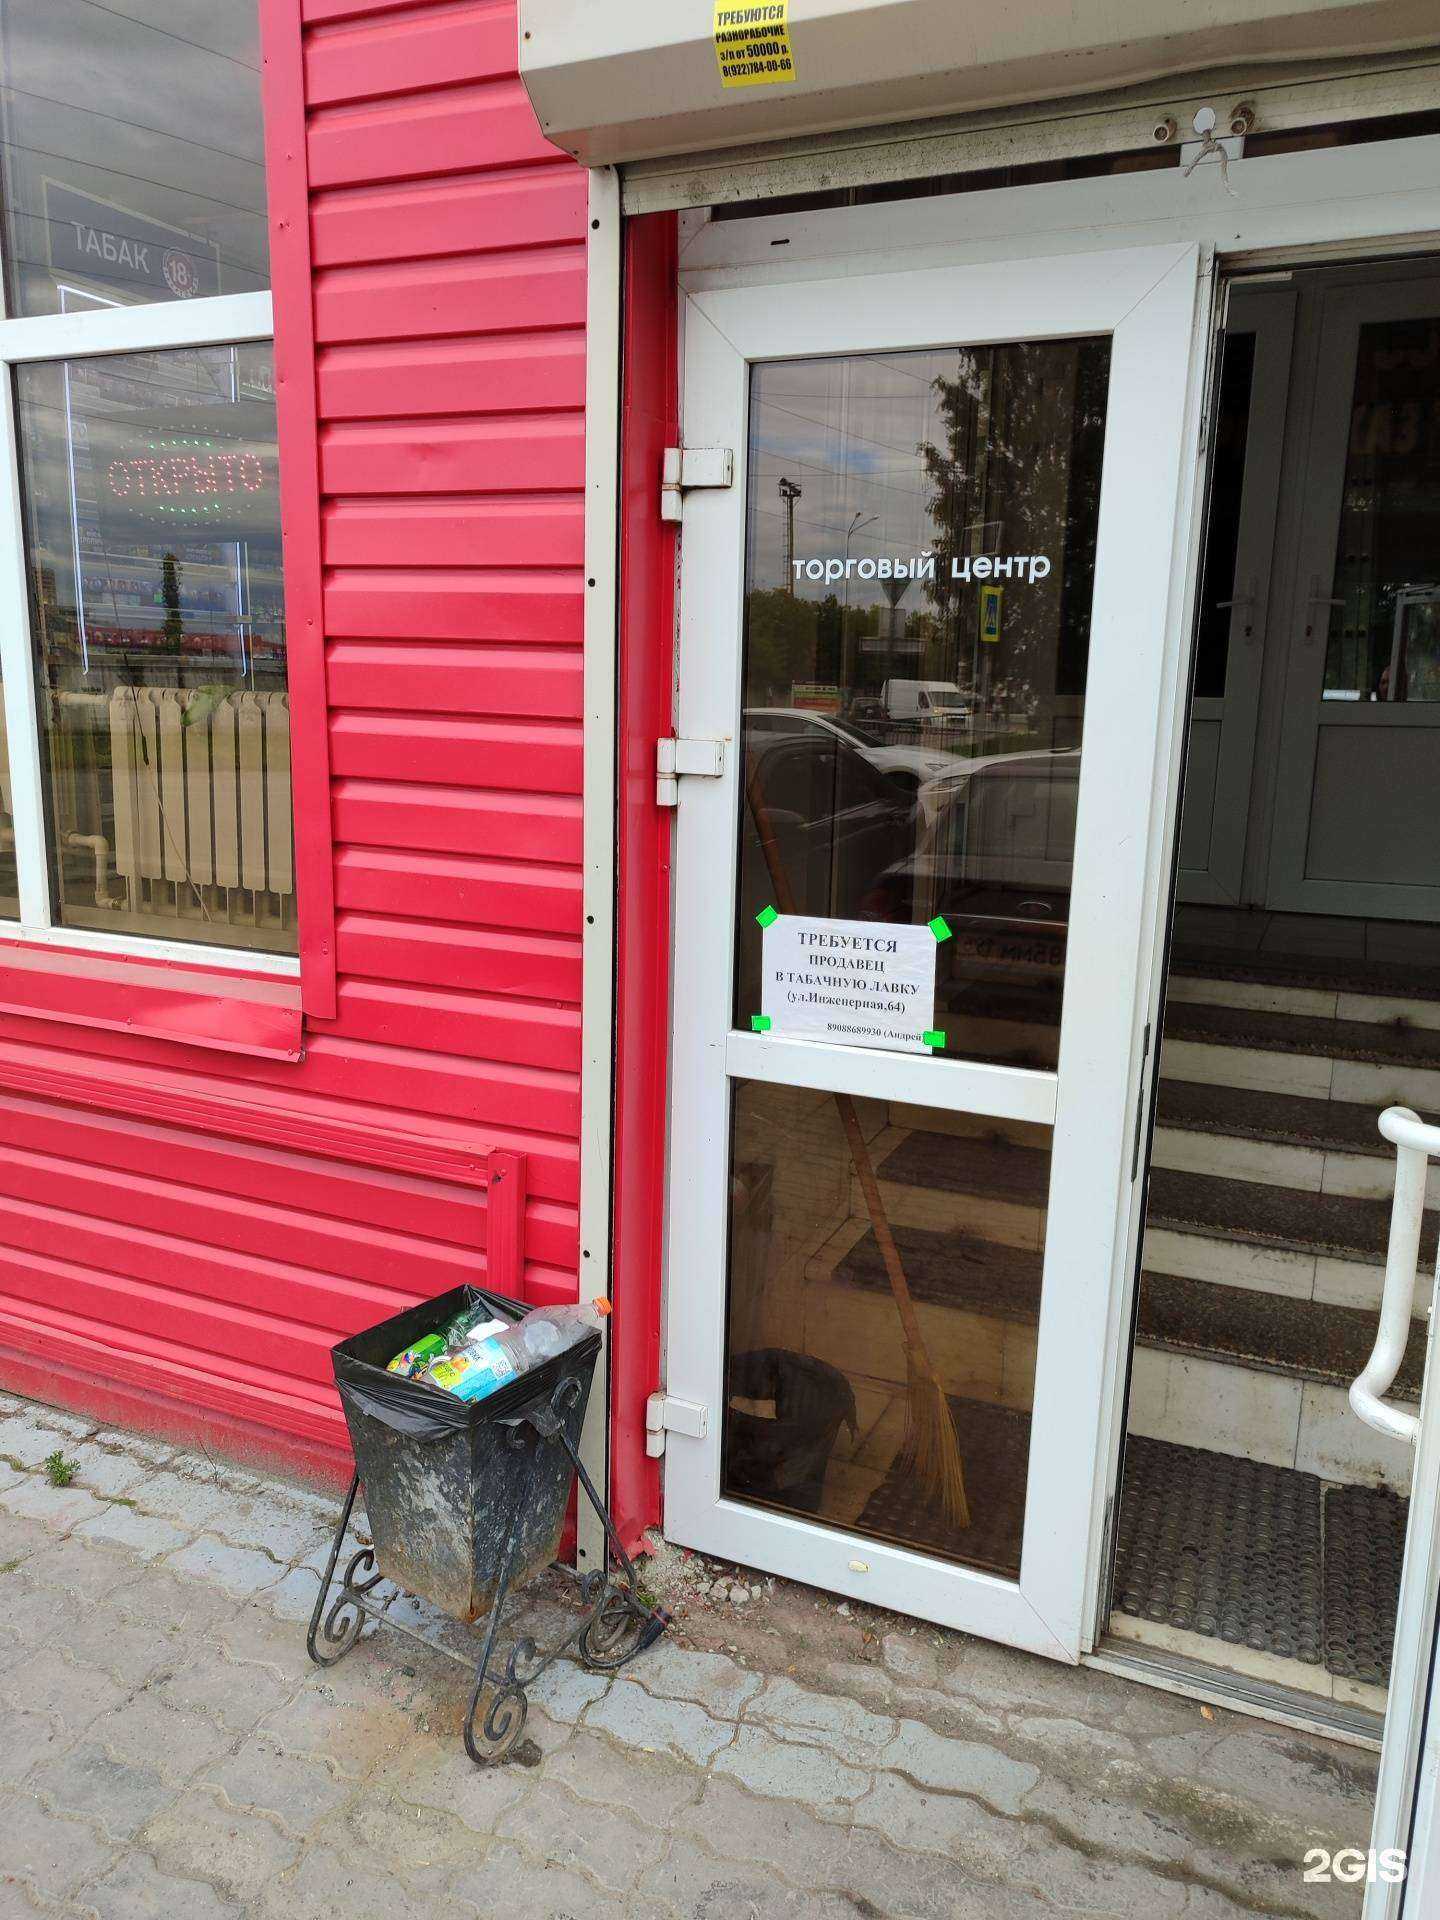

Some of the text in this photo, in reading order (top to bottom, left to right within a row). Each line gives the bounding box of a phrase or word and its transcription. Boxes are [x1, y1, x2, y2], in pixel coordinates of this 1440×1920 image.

[717, 4, 784, 27] ТРЕБУЮТСЯ
[715, 24, 785, 43] РАЗНОРАБОЧИЕ
[736, 49, 746, 60] от
[746, 41, 779, 58] 50000
[70, 220, 150, 274] ТАБАК
[108, 453, 263, 496] ОТКРЫТО
[792, 550, 1051, 585] торговый центр
[797, 932, 898, 953] ТРЕБУЕТСЯ
[809, 954, 885, 973] ПРОДАВЕЦ
[775, 971, 920, 995] В ТАБАЧНУЮ ЛАВКУ
